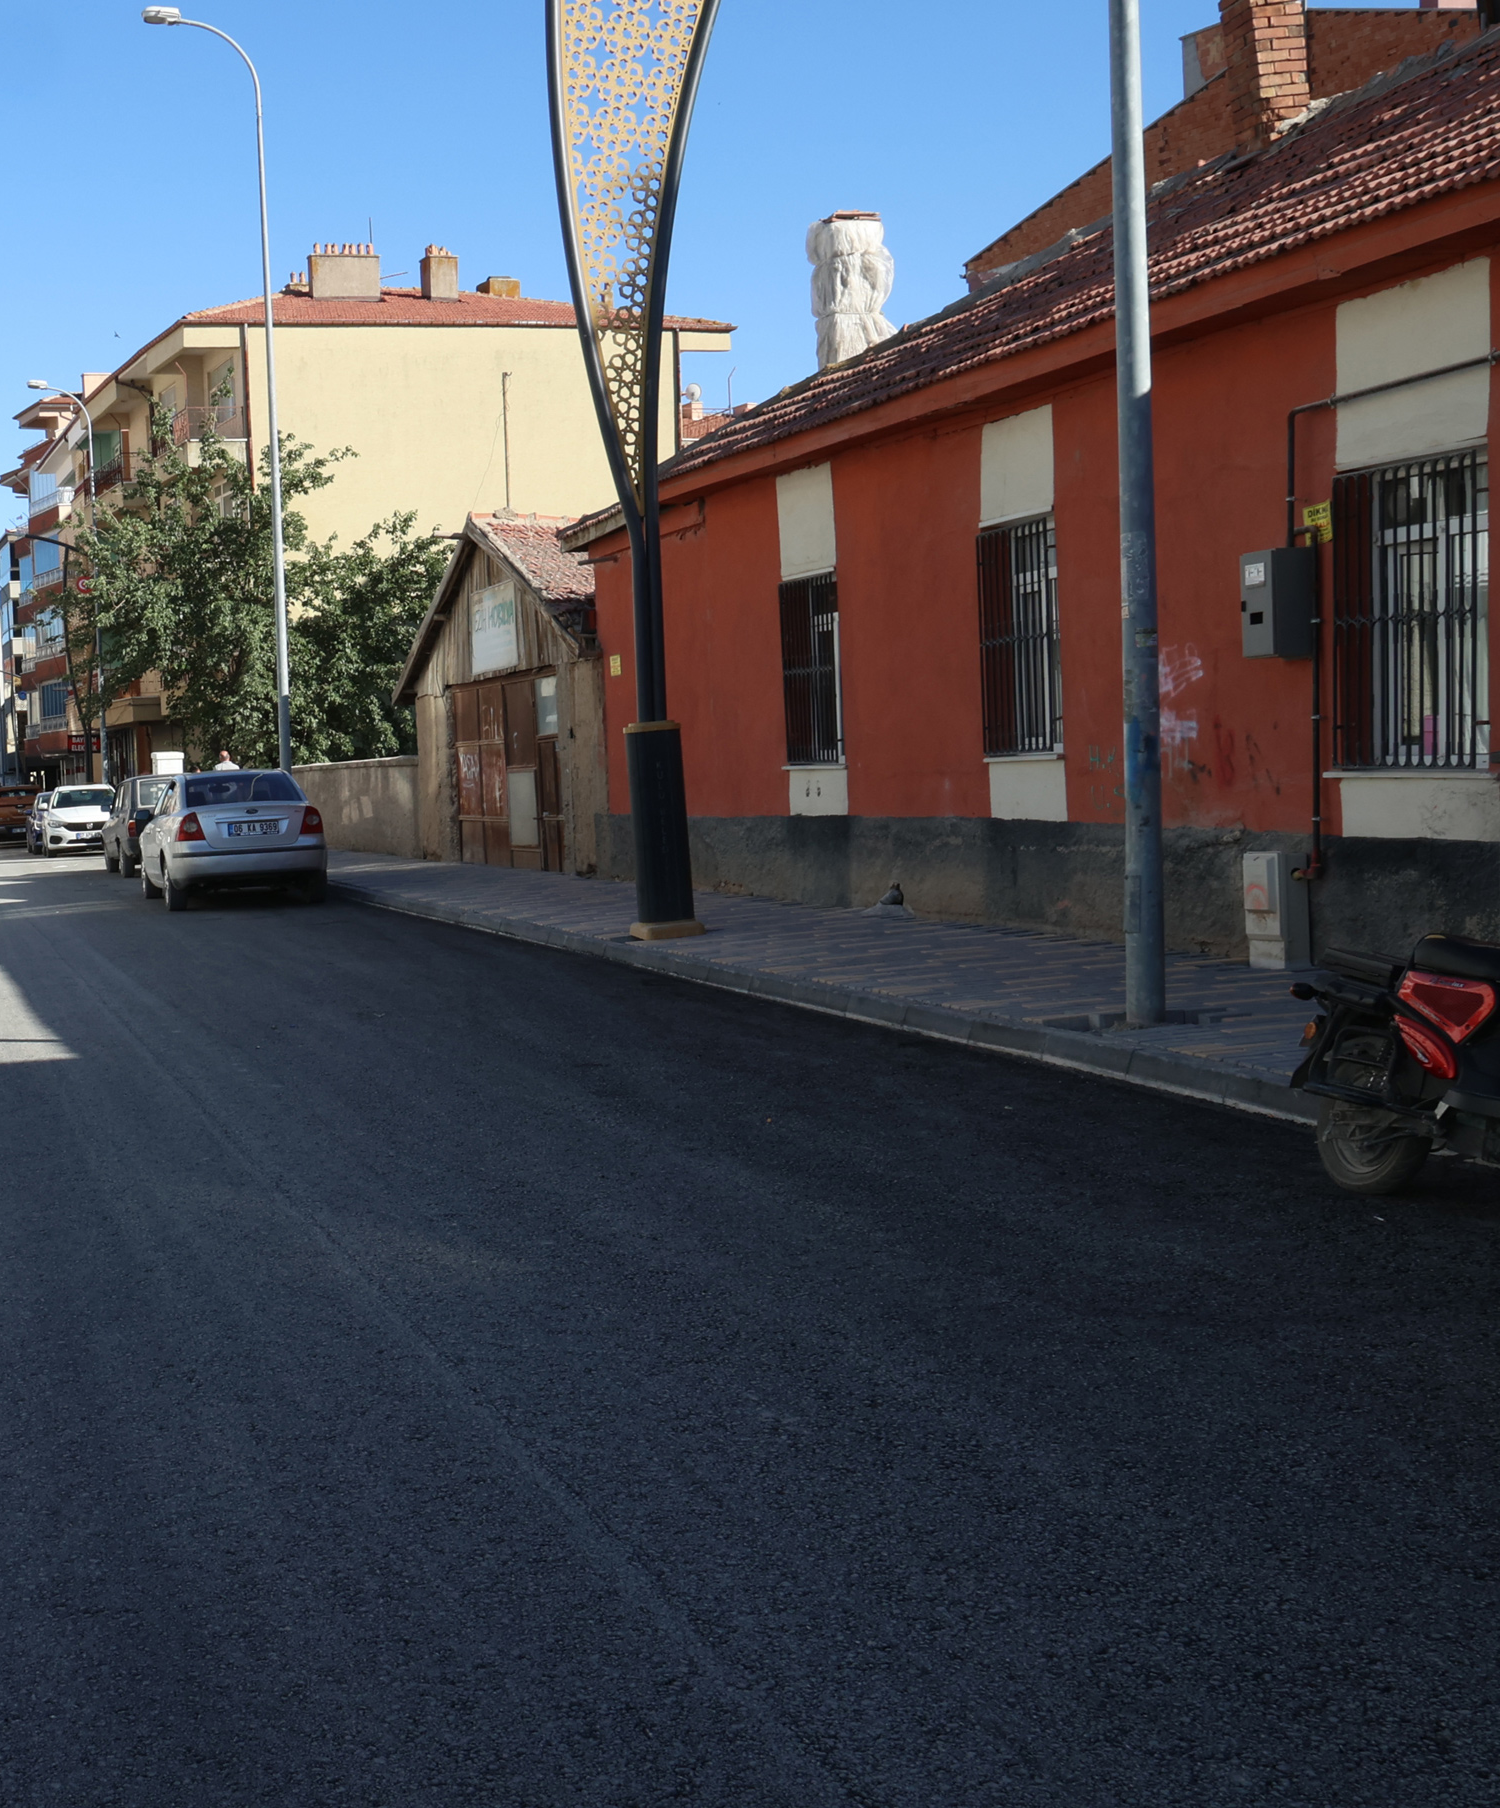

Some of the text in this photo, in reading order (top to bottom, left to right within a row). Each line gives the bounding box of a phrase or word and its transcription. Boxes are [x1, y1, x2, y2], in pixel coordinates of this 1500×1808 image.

[71, 744, 97, 752] ELEKK
[233, 822, 278, 833] 06 KA 9369
